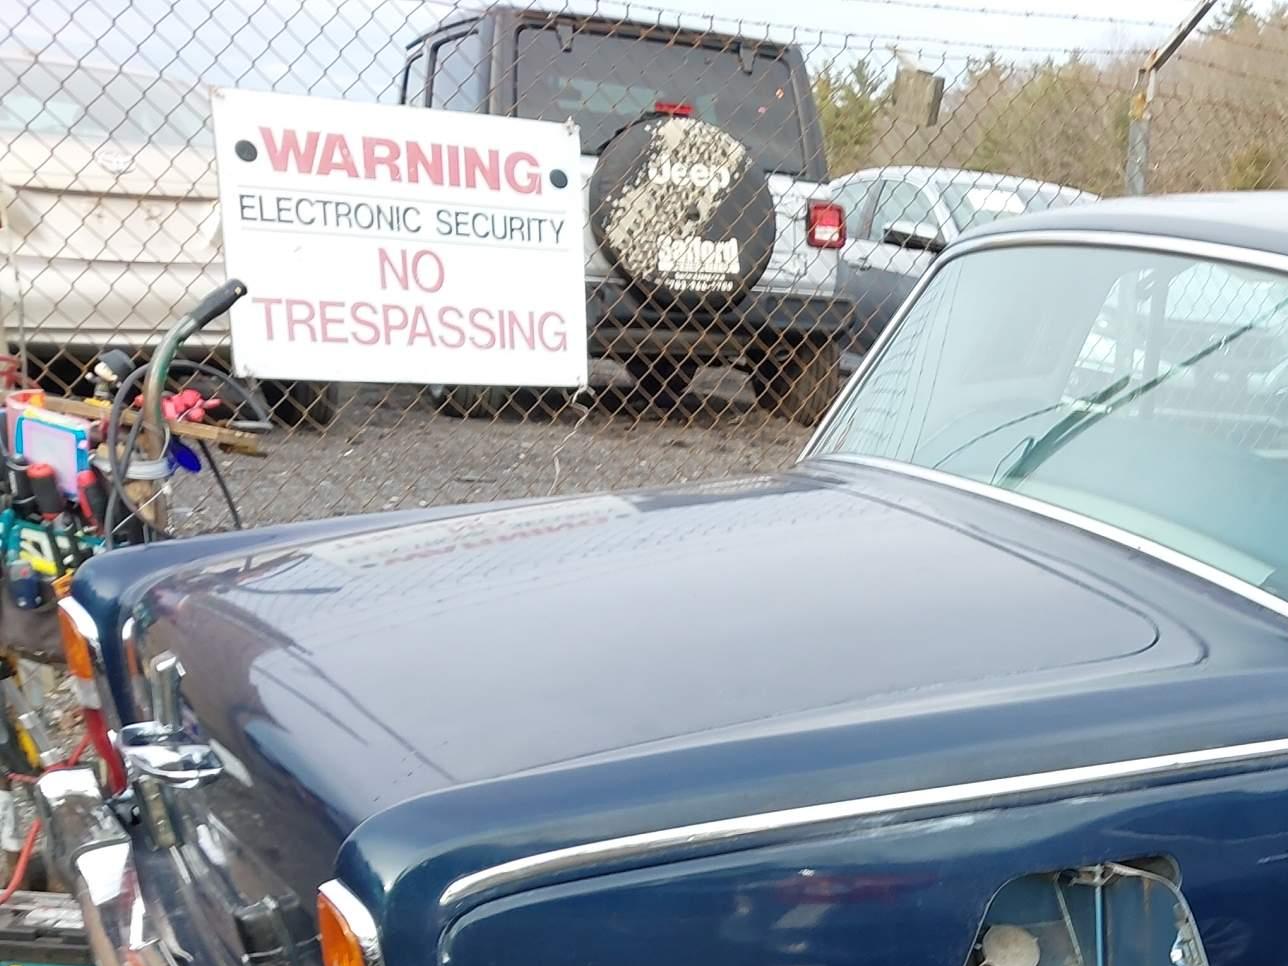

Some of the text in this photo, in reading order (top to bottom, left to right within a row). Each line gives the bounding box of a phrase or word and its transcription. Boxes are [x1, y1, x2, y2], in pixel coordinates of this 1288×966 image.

[258, 126, 542, 195] WARNING
[648, 153, 730, 191] Jeep
[239, 194, 565, 244] ELECTRONIC SECURITY
[377, 247, 445, 294] NO
[252, 296, 568, 352] TRESPASSING
